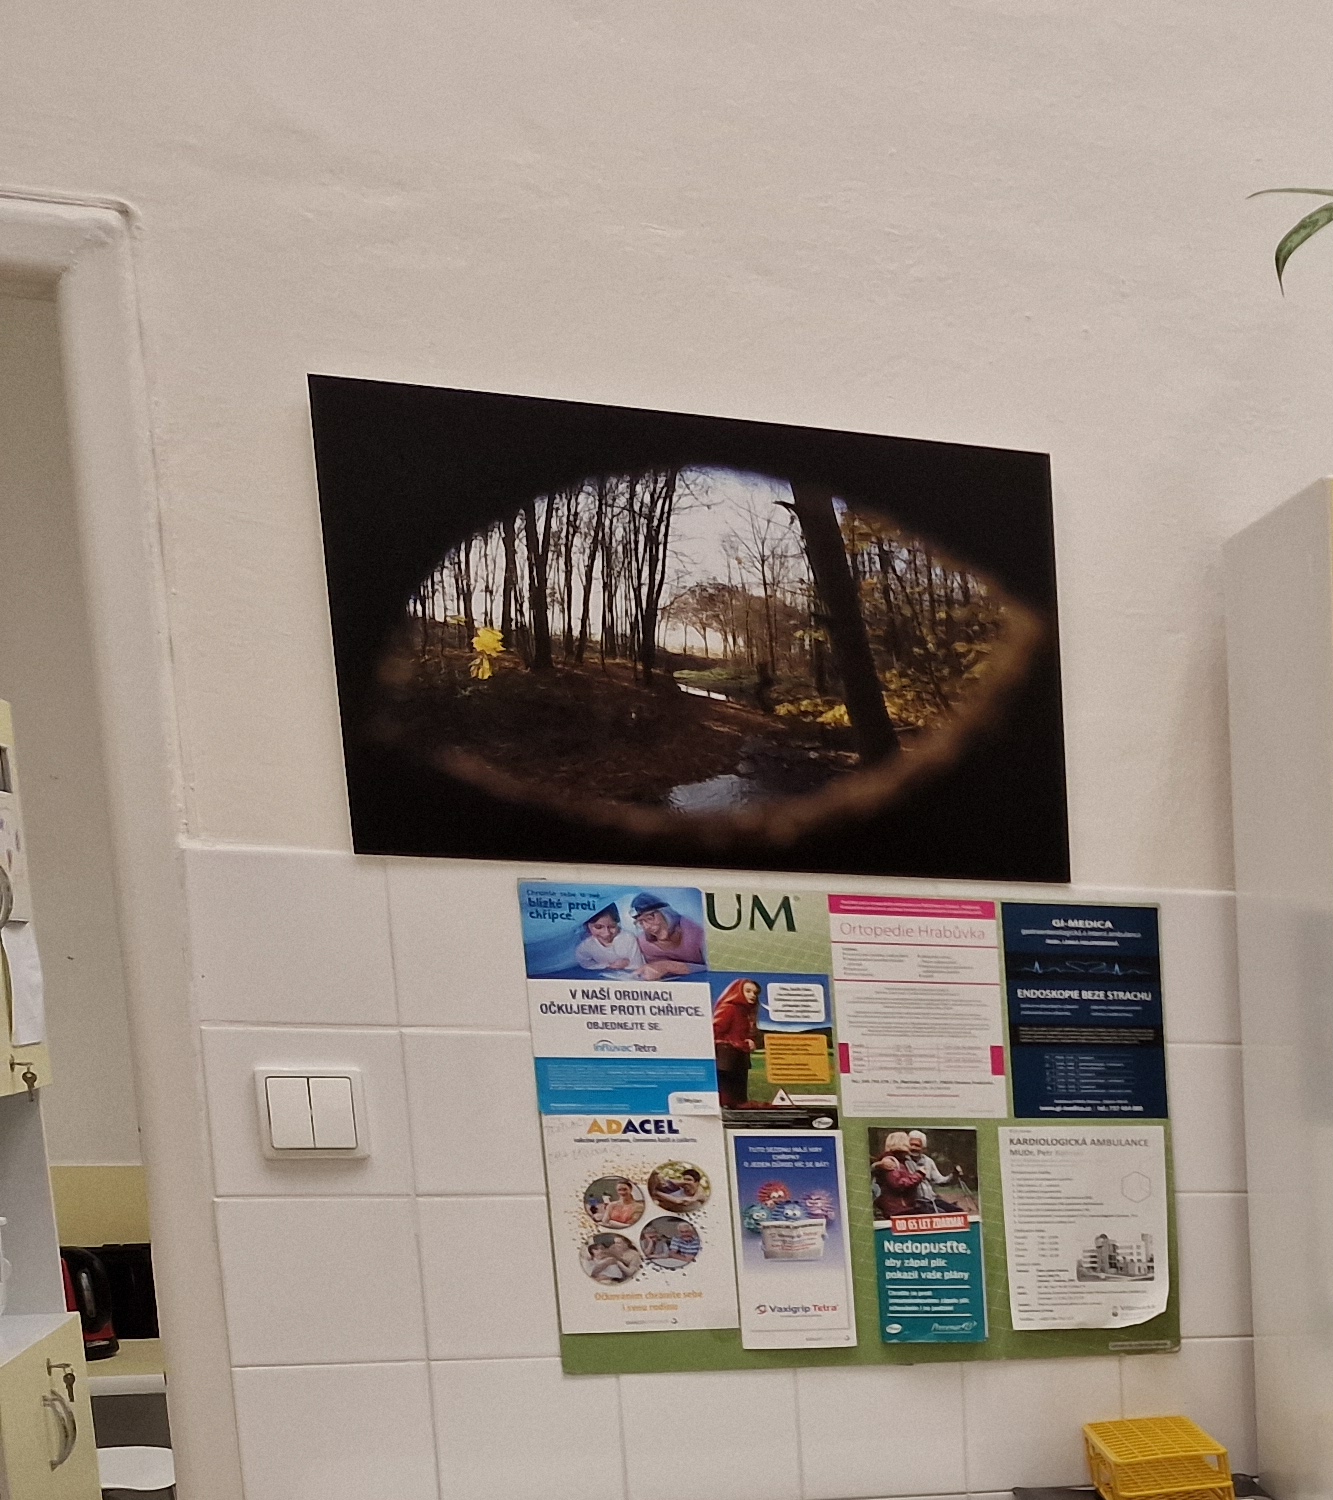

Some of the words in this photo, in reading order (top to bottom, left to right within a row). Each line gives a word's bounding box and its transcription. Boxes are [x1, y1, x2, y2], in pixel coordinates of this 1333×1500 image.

[839, 921, 914, 939] Ortopedie
[918, 925, 986, 941] Hrabůvka
[569, 988, 578, 1000] V
[581, 987, 611, 1001] NAŠÍ
[614, 989, 673, 1002] ORDINACI
[1016, 988, 1081, 1000] ENDOSKOPIE
[1081, 989, 1105, 1001] BEZE
[1107, 990, 1152, 1002] STRACHU
[539, 1001, 607, 1016] OČKUJEME
[610, 1005, 646, 1016] PROTI
[650, 1004, 705, 1017] CHŘIPCE.
[586, 1021, 646, 1031] OBJEDNEJTE
[586, 1118, 681, 1136] ADACEL
[1008, 1137, 1088, 1147] KARDIOLOGICKÁ
[1089, 1138, 1149, 1147] AMBULANCE
[918, 1218, 931, 1230] LET
[884, 1258, 901, 1268] aby
[903, 1257, 929, 1268] zápal
[768, 1304, 811, 1314] Vaxigrip
[812, 1304, 838, 1312] Tetra
